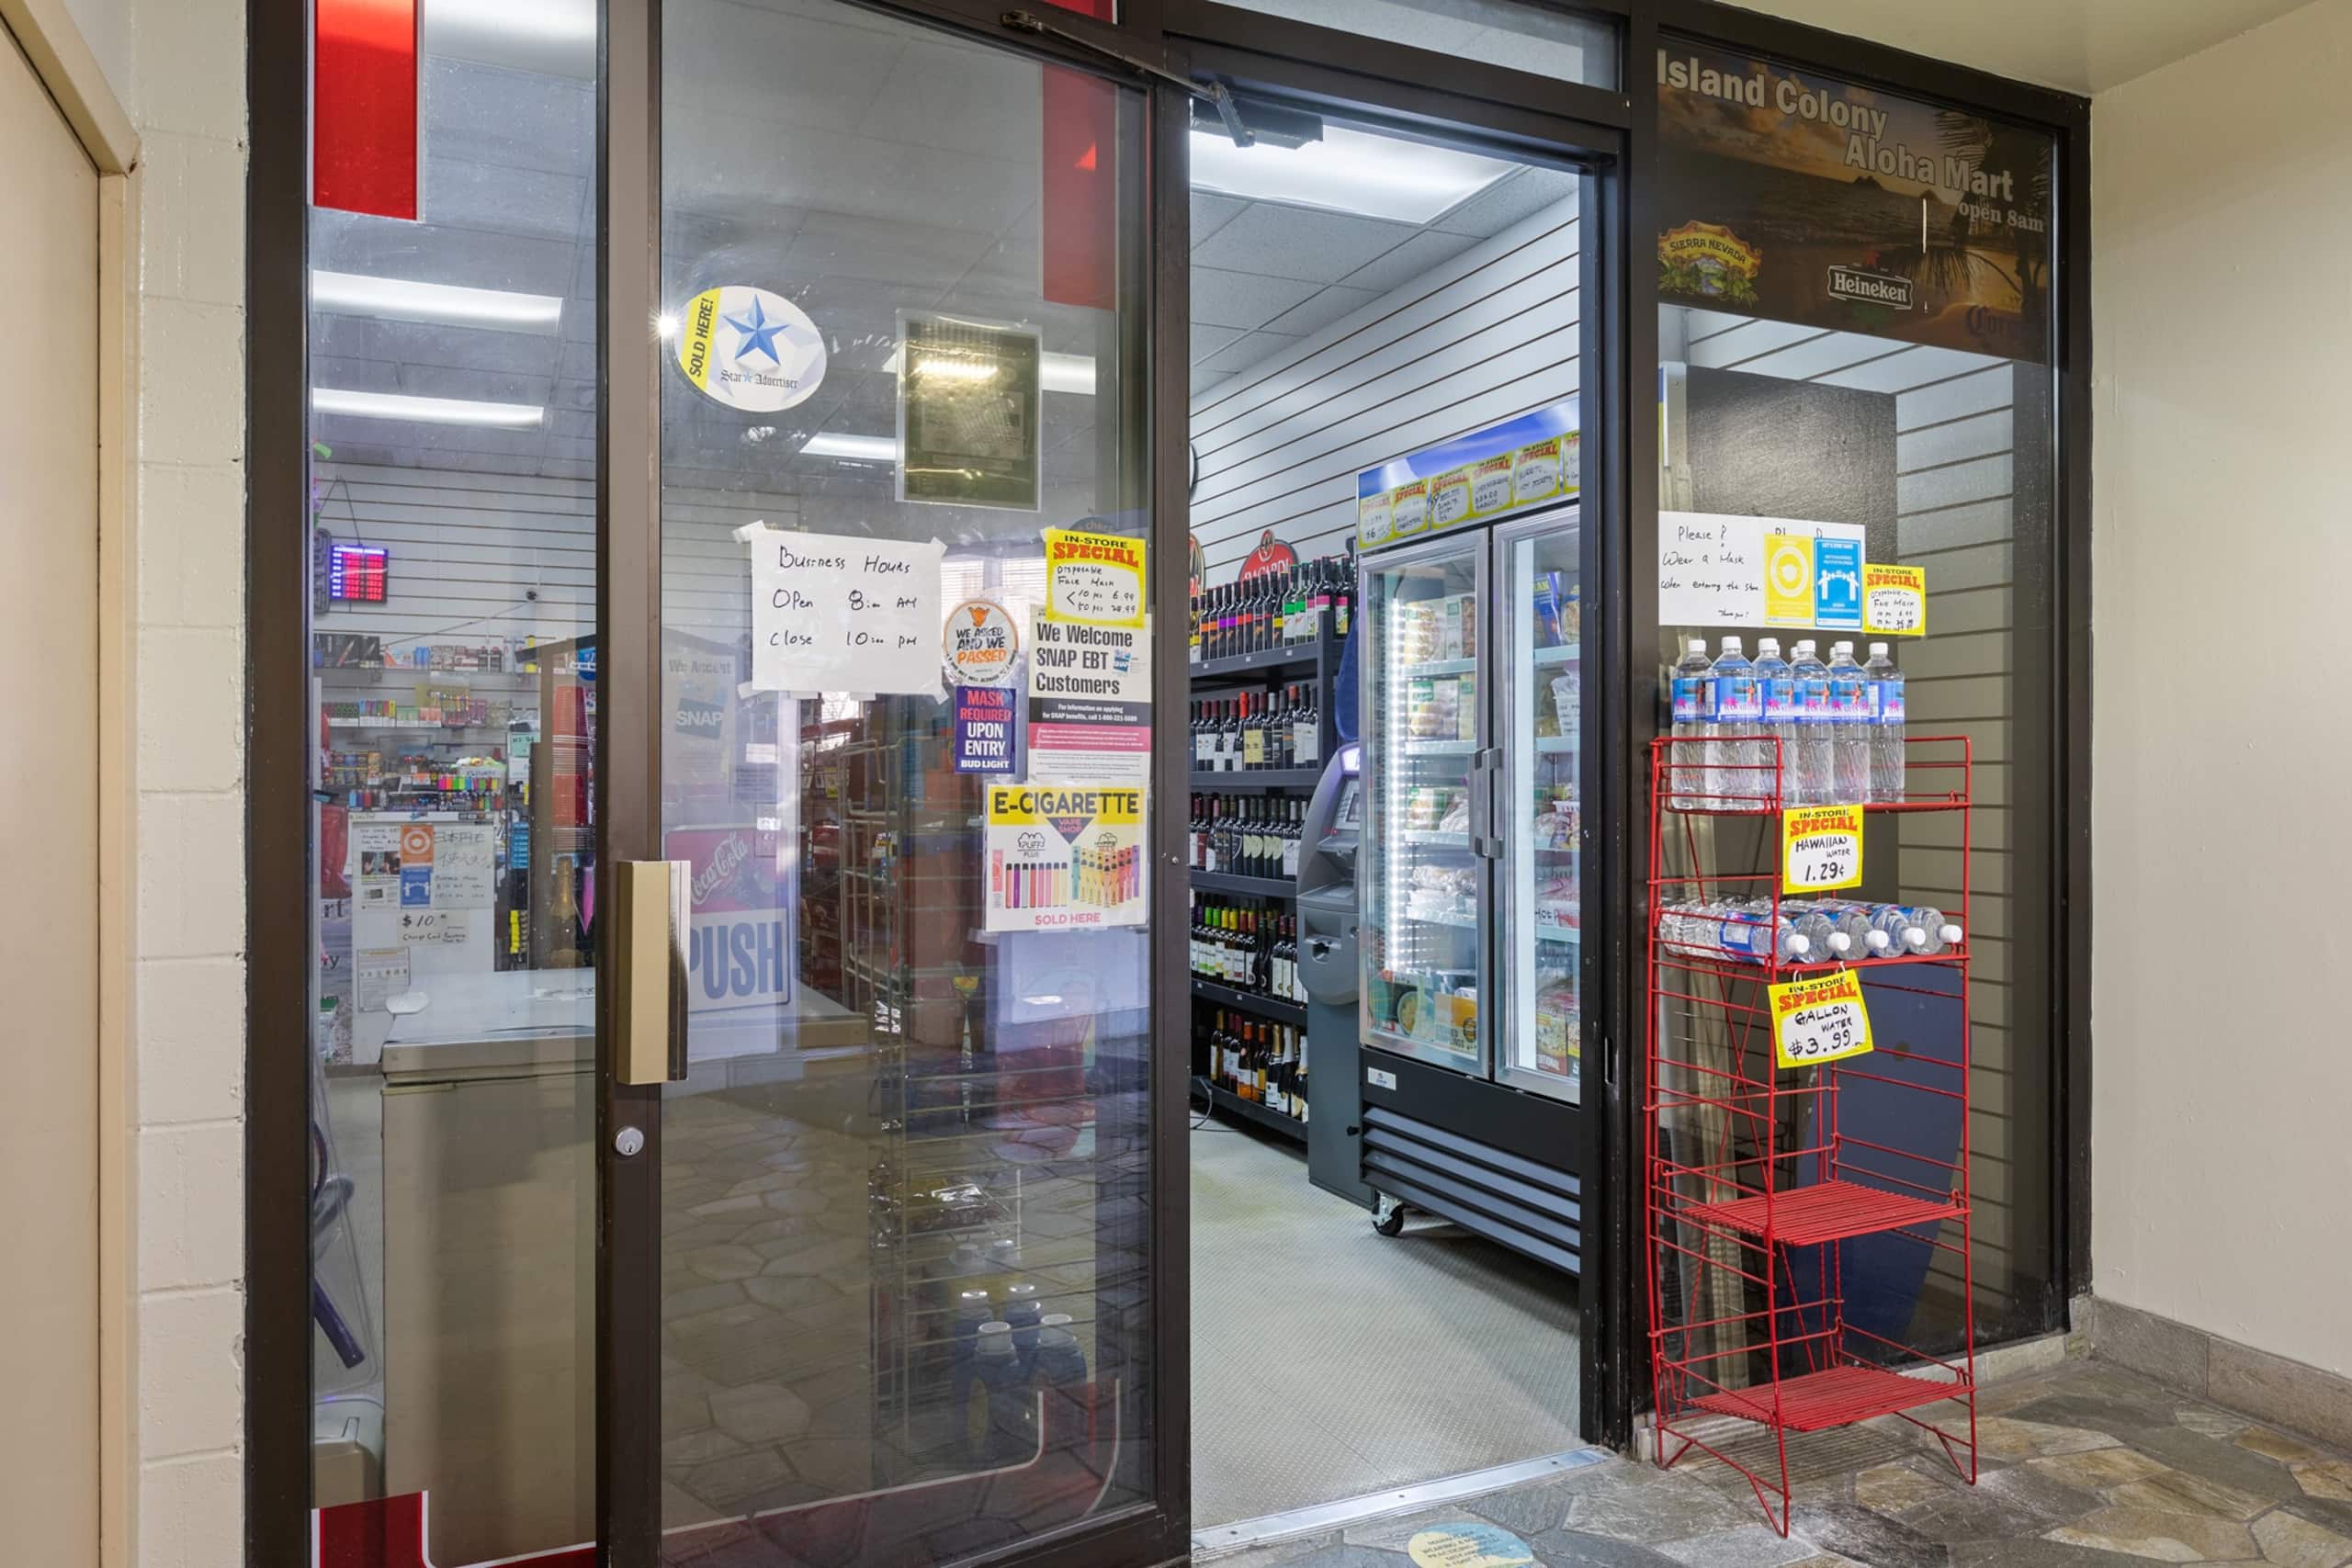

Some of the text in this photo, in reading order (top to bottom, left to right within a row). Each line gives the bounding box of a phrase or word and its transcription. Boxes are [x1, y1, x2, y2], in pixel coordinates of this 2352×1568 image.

[1657, 49, 1888, 141] Island Colony
[1845, 134, 2013, 202] Aloha Mart
[2007, 209, 2043, 232] 8am
[1669, 238, 1747, 265] SIERRA NEVADA
[1834, 272, 1908, 302] Heineken
[689, 298, 714, 377] SOLD HERE!
[755, 373, 798, 389] Advertiser
[1064, 535, 1129, 548] IN-STORE
[1678, 525, 1713, 542] Please
[779, 544, 911, 574] Business Hours
[1054, 541, 1139, 569] SPECIAL
[1661, 551, 1694, 566] Wear
[1057, 576, 1080, 585] Face
[1866, 573, 1921, 591] SPECIAL
[956, 626, 1004, 638] WE ASKED
[1036, 623, 1133, 647] We Welcome
[956, 637, 1006, 650] AND WE
[957, 649, 1008, 665] PASSED
[1036, 648, 1108, 670] SNAP EBT
[1036, 672, 1120, 694] Customers
[967, 690, 1004, 706] MASK
[960, 707, 1012, 722] REQUIRED
[1067, 704, 1095, 712] information
[675, 710, 723, 726] SNAP
[967, 722, 1004, 739] UPON
[965, 739, 1006, 756] ENTRY
[960, 760, 1010, 769] BUD LIGHT
[994, 792, 1139, 815] E-CIGARETTE
[1799, 808, 1849, 819] IN-STORE
[1057, 818, 1082, 826] VAPE
[1057, 826, 1082, 834] SHOP
[1790, 816, 1858, 837] SPECIAL
[1795, 836, 1848, 852] HAWAIIAN
[1826, 848, 1851, 857] WATER
[1035, 912, 1101, 925] SOLD HERE
[1779, 982, 1859, 1012] SPECIAL
[1794, 1004, 1849, 1026] GALLON
[1821, 1017, 1853, 1033] WATER
